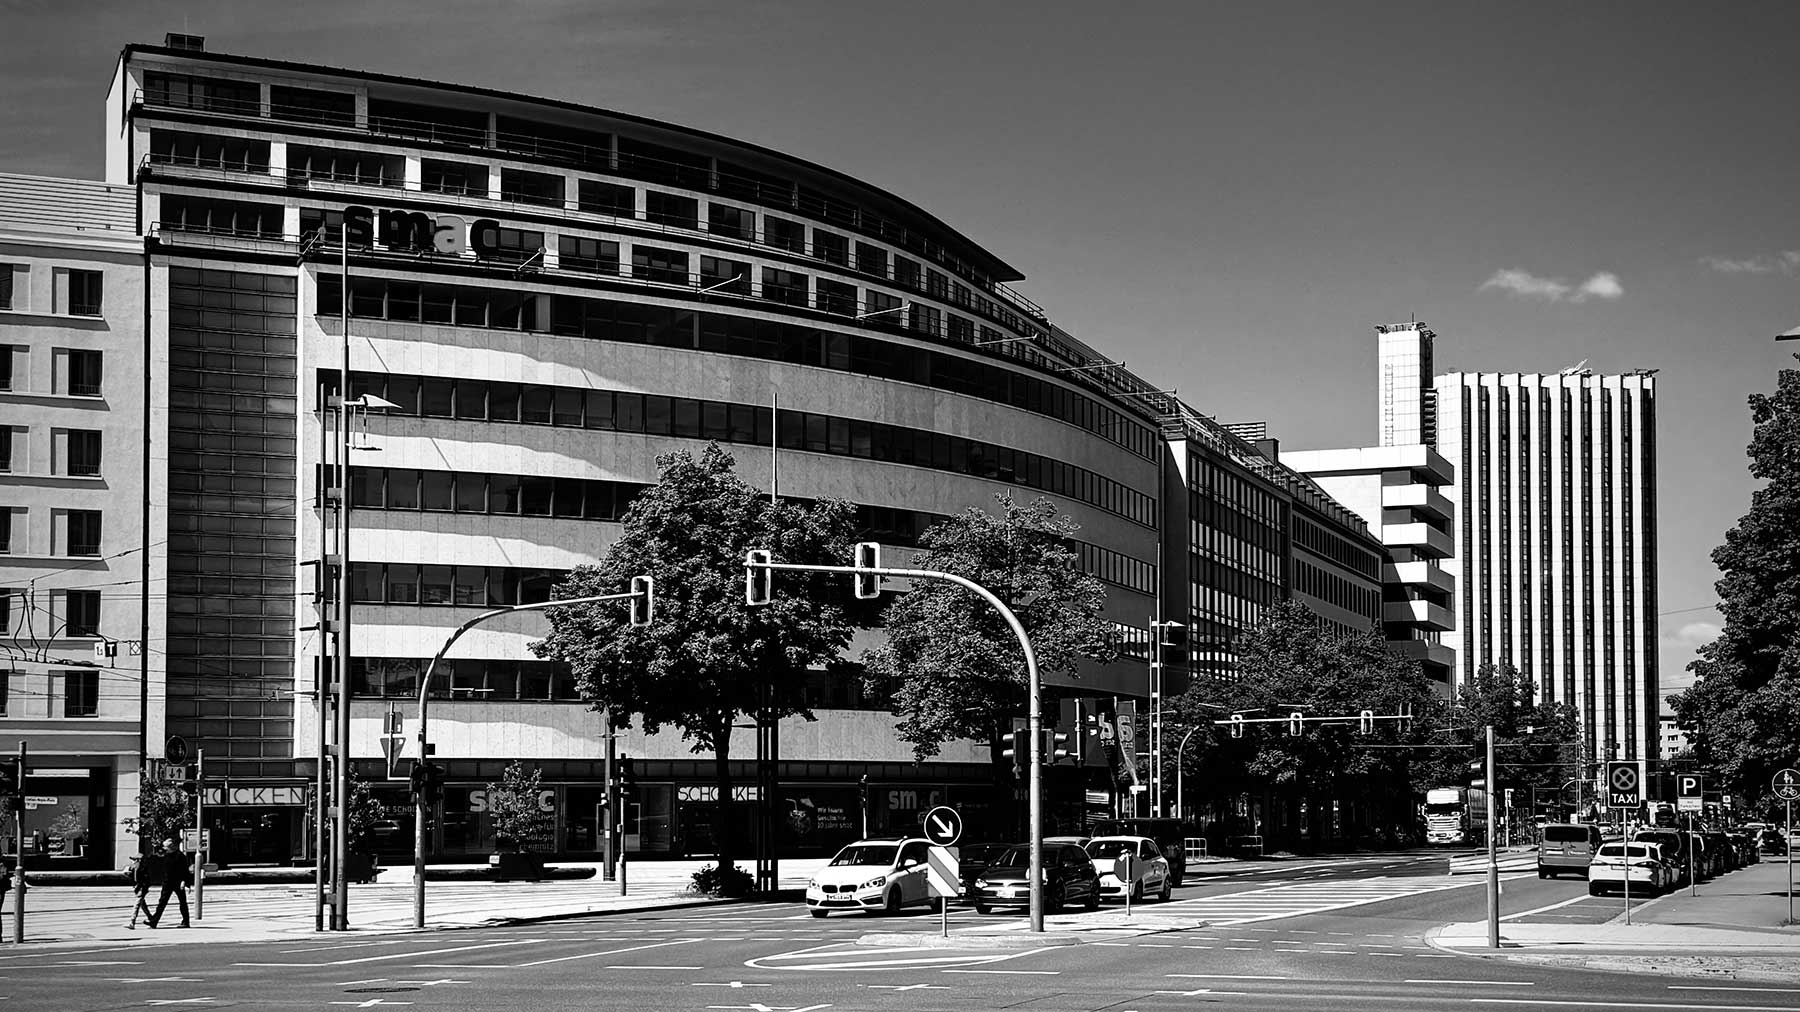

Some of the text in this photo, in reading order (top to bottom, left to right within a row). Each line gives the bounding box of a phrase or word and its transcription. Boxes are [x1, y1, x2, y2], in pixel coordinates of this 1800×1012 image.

[343, 206, 500, 256] smac
[677, 786, 764, 801] SCHOKE
[1683, 777, 1696, 795] P
[469, 790, 554, 811] smc
[888, 790, 940, 810] smc
[1611, 793, 1637, 804] TAXI
